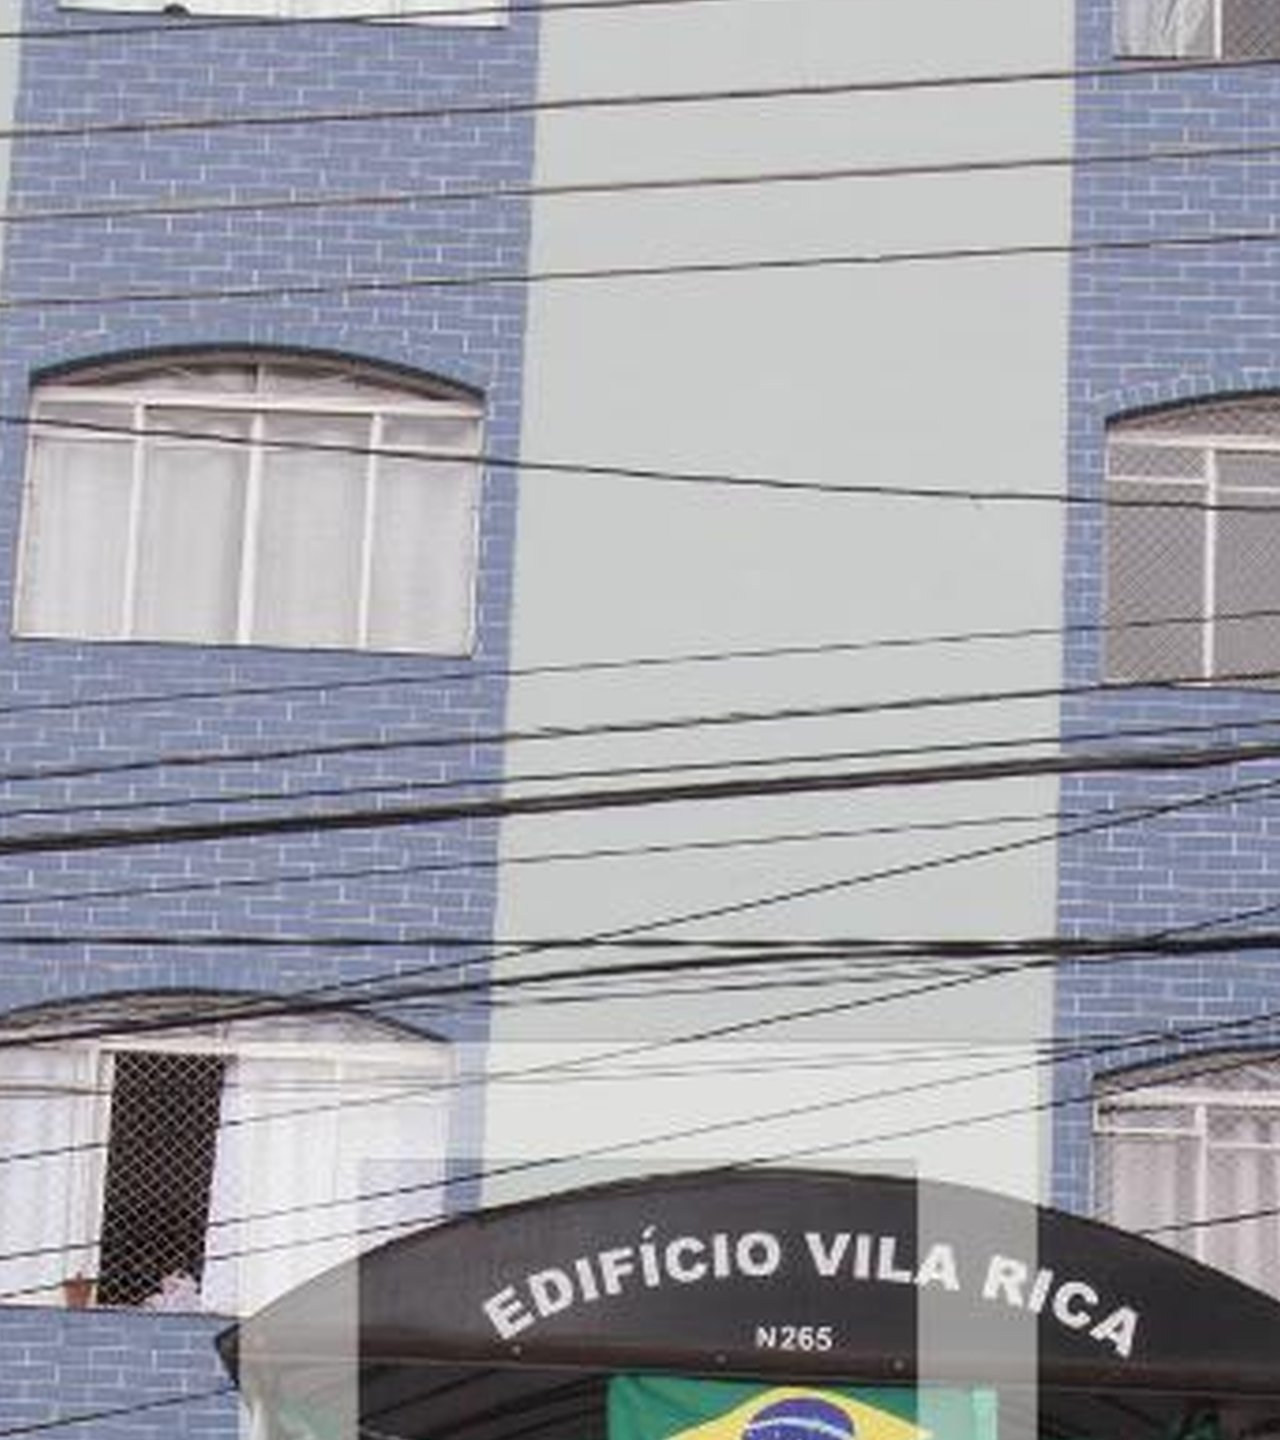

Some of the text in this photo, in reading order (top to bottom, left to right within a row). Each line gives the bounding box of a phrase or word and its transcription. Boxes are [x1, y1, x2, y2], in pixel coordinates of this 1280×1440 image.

[482, 1224, 1138, 1357] EDIFÍCIO VILA RICA
